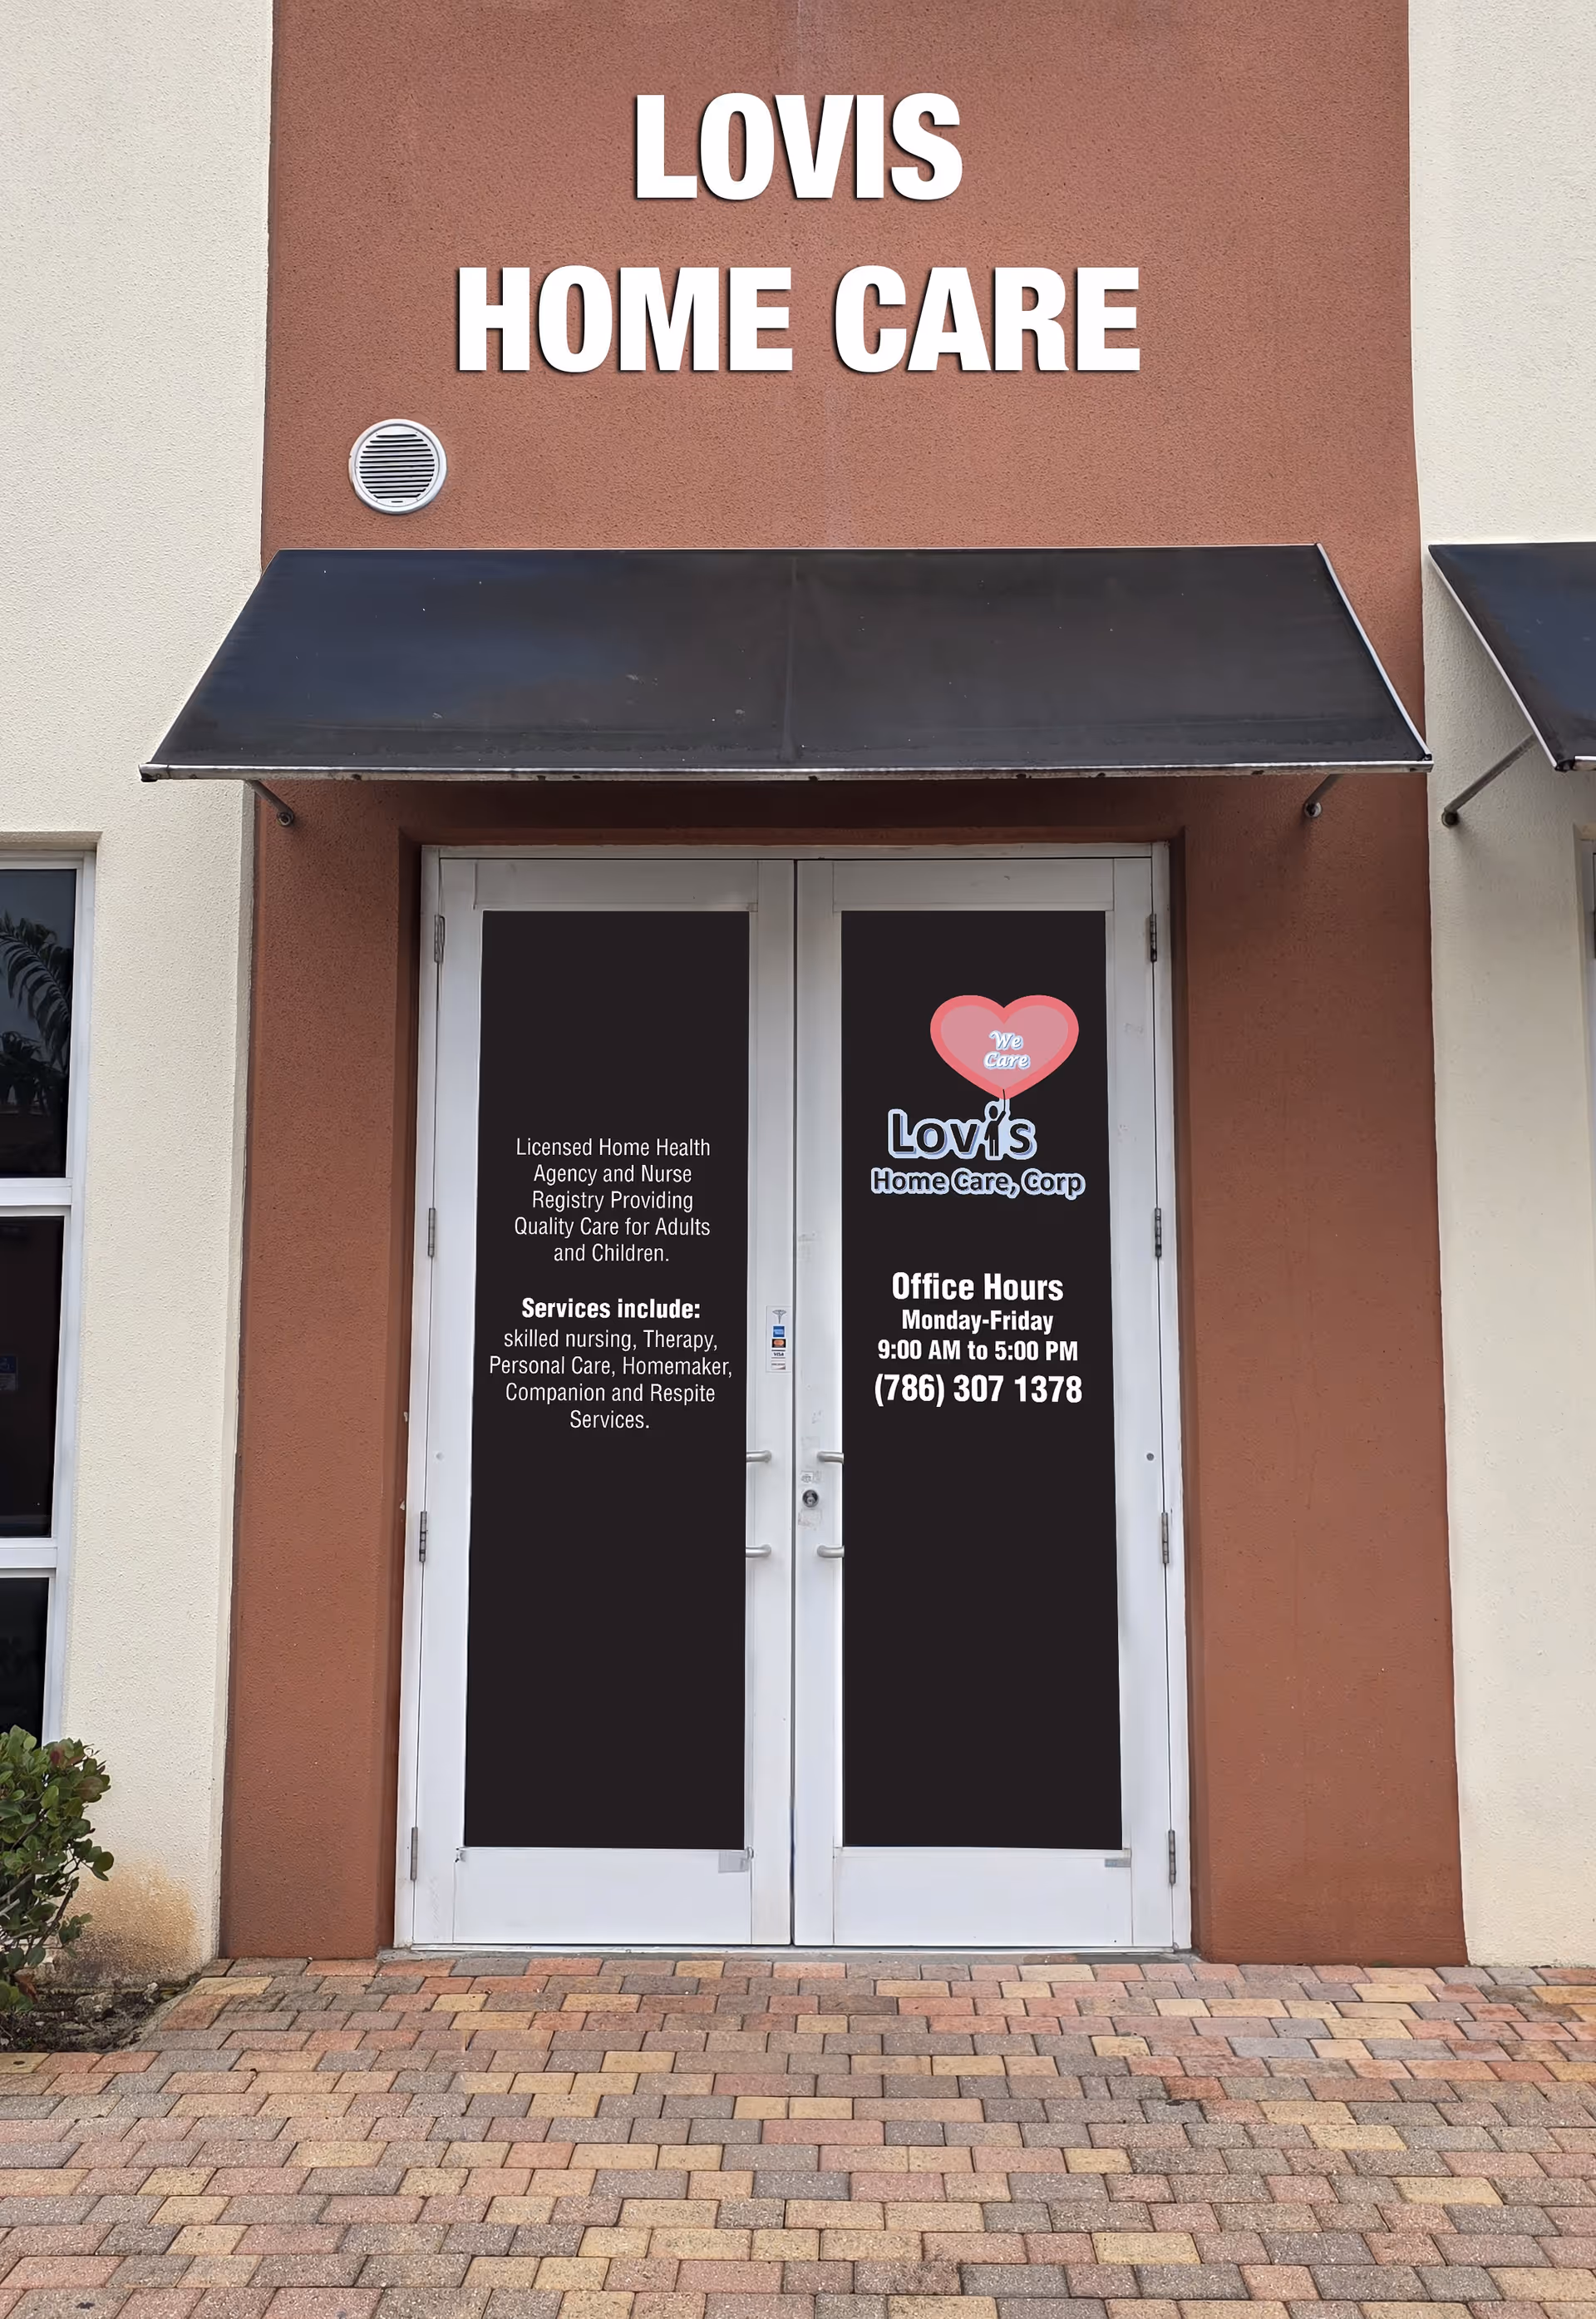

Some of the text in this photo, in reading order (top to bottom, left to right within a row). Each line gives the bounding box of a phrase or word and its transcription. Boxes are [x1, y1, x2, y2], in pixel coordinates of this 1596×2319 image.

[635, 93, 963, 201] LOVIS
[457, 265, 1141, 373] HOME CARE
[988, 1030, 1023, 1050] We
[983, 1051, 1031, 1069] Care
[516, 1137, 710, 1157] Licensed Home Health
[533, 1163, 692, 1187] Agency and Nurse
[872, 1168, 1086, 1200] Home Care, Corp
[532, 1190, 693, 1213] Registry Providing
[515, 1216, 711, 1239] Quality Care for Adults
[554, 1243, 669, 1262] and Children.
[892, 1271, 1064, 1301] Office Hours
[521, 1297, 701, 1320] Services include:
[902, 1309, 1054, 1335] Monday-Friday
[504, 1329, 717, 1353] skilled nursing, Therapy,
[877, 1339, 1078, 1361] 9:00 AM to 5:00 PM
[490, 1355, 732, 1379] Personal Care, Homemaker,
[505, 1382, 716, 1406] Companion and Respite
[874, 1373, 1082, 1408] (786) 307 1378
[569, 1409, 649, 1428] Services.
